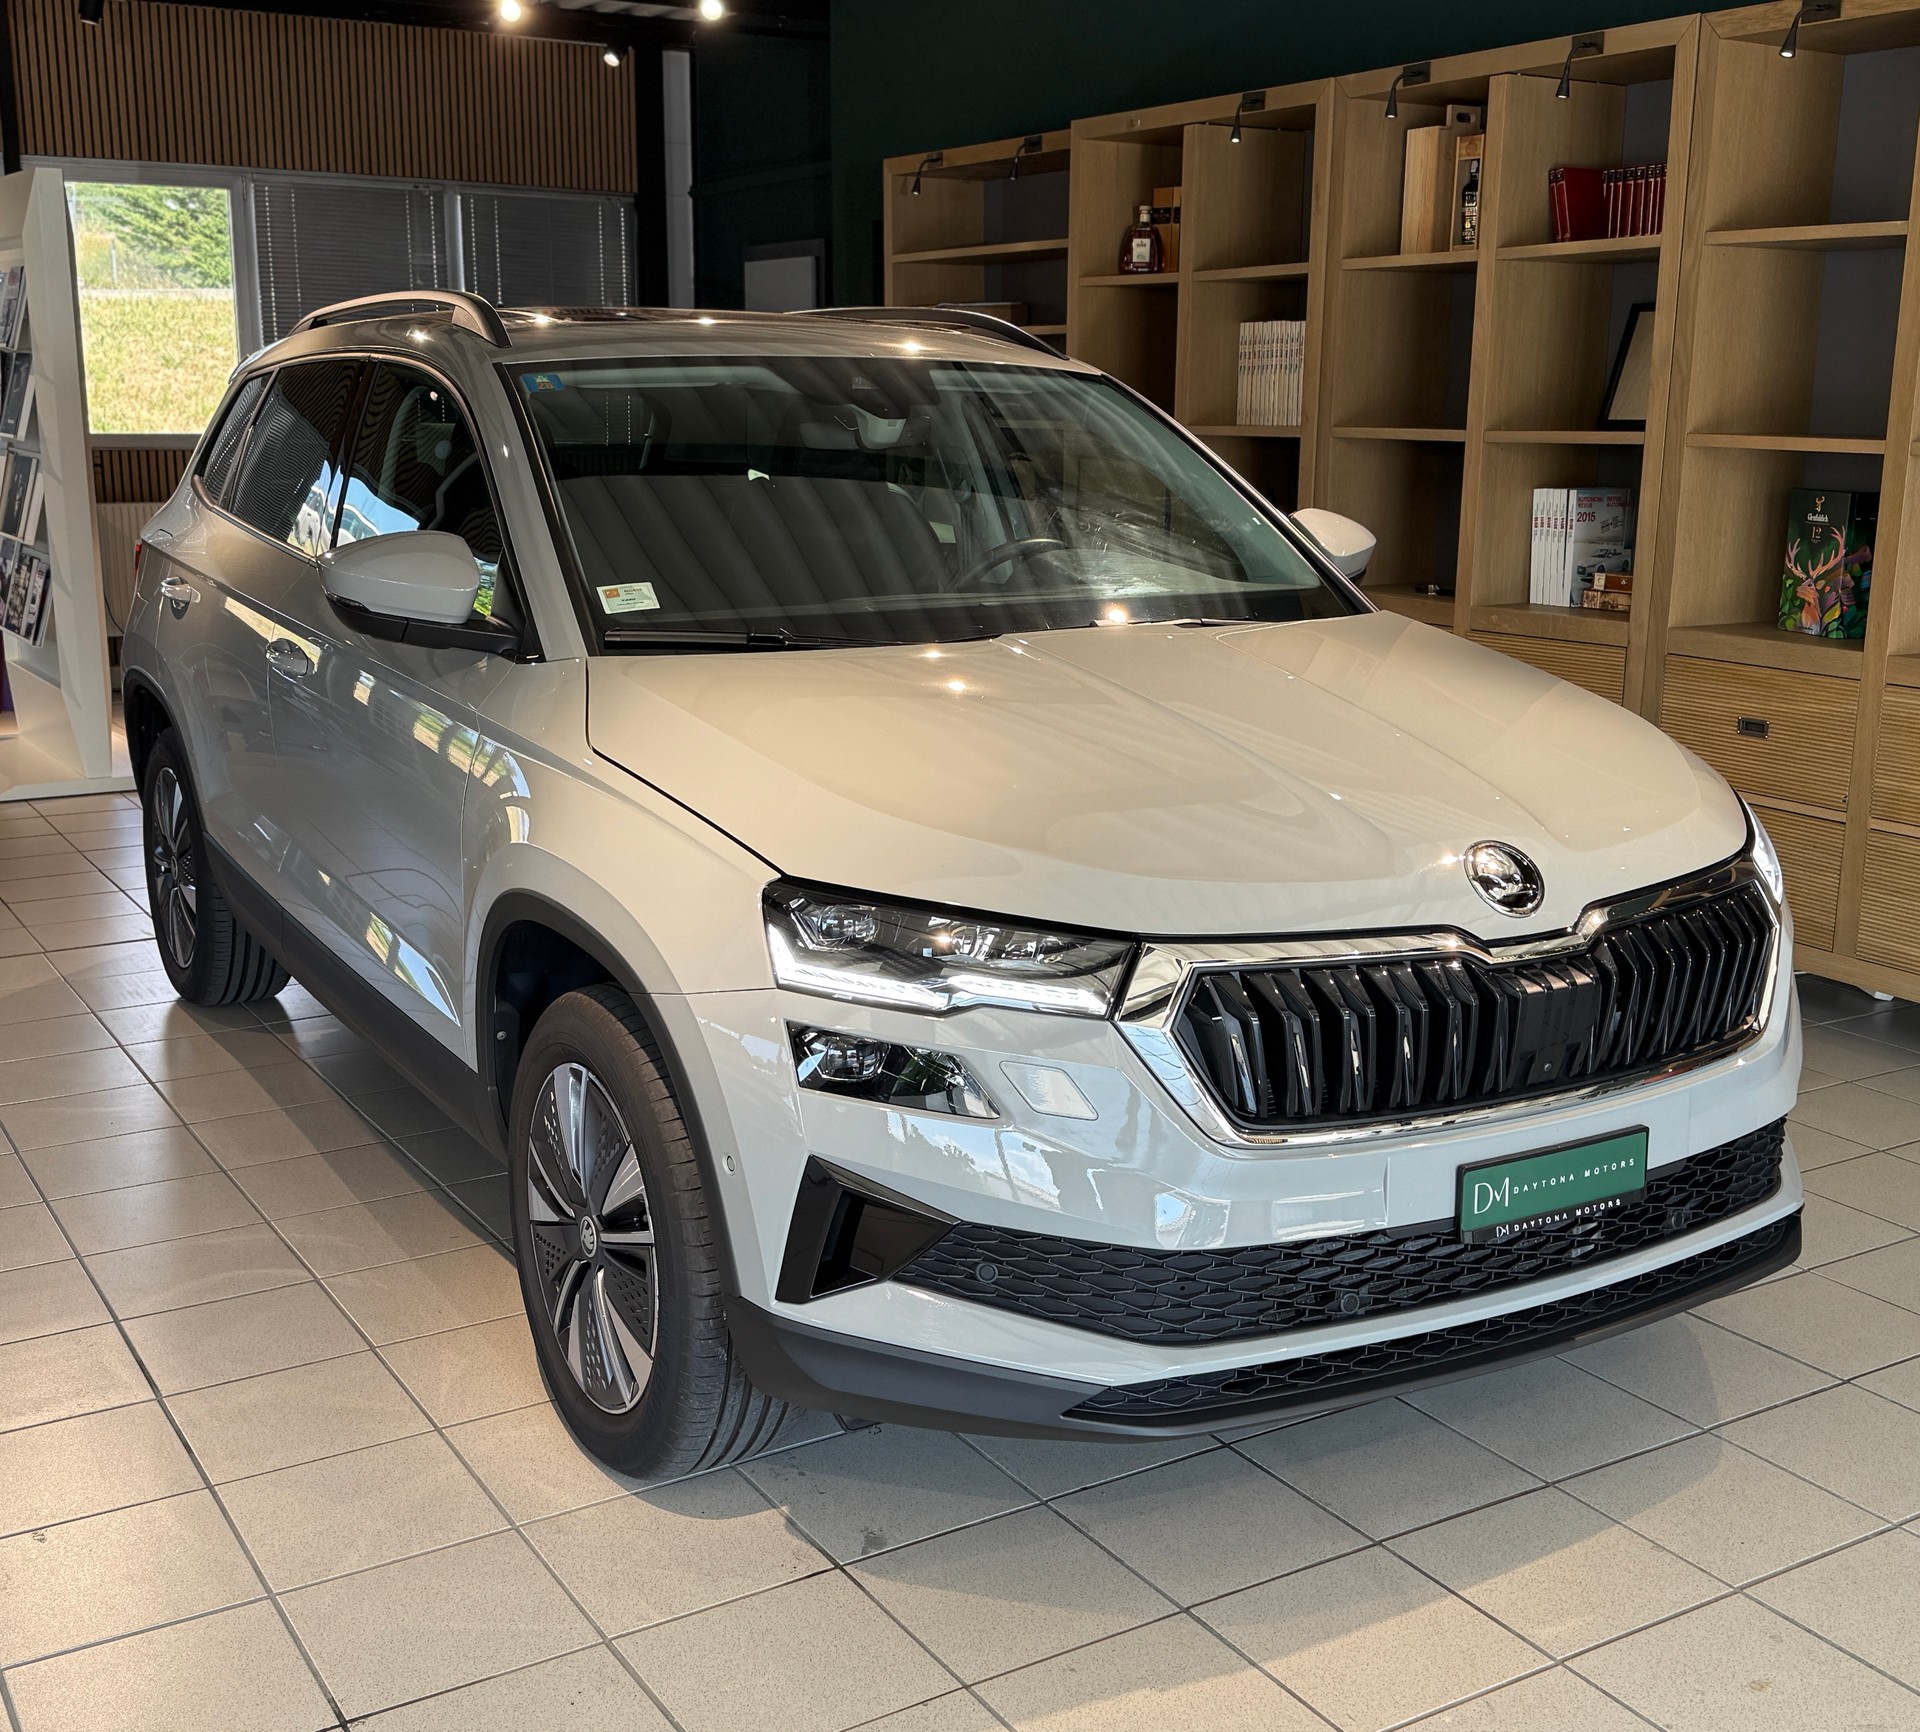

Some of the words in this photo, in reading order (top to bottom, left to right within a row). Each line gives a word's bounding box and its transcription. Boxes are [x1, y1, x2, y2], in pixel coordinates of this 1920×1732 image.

[1576, 511, 1596, 522] 2015
[1474, 1176, 1510, 1215] DM
[1514, 1174, 1575, 1194] DAYTONA
[1584, 1158, 1635, 1177] MOTORS
[1514, 1212, 1568, 1232] DAYTONA
[1575, 1198, 1621, 1216] MOTORS
